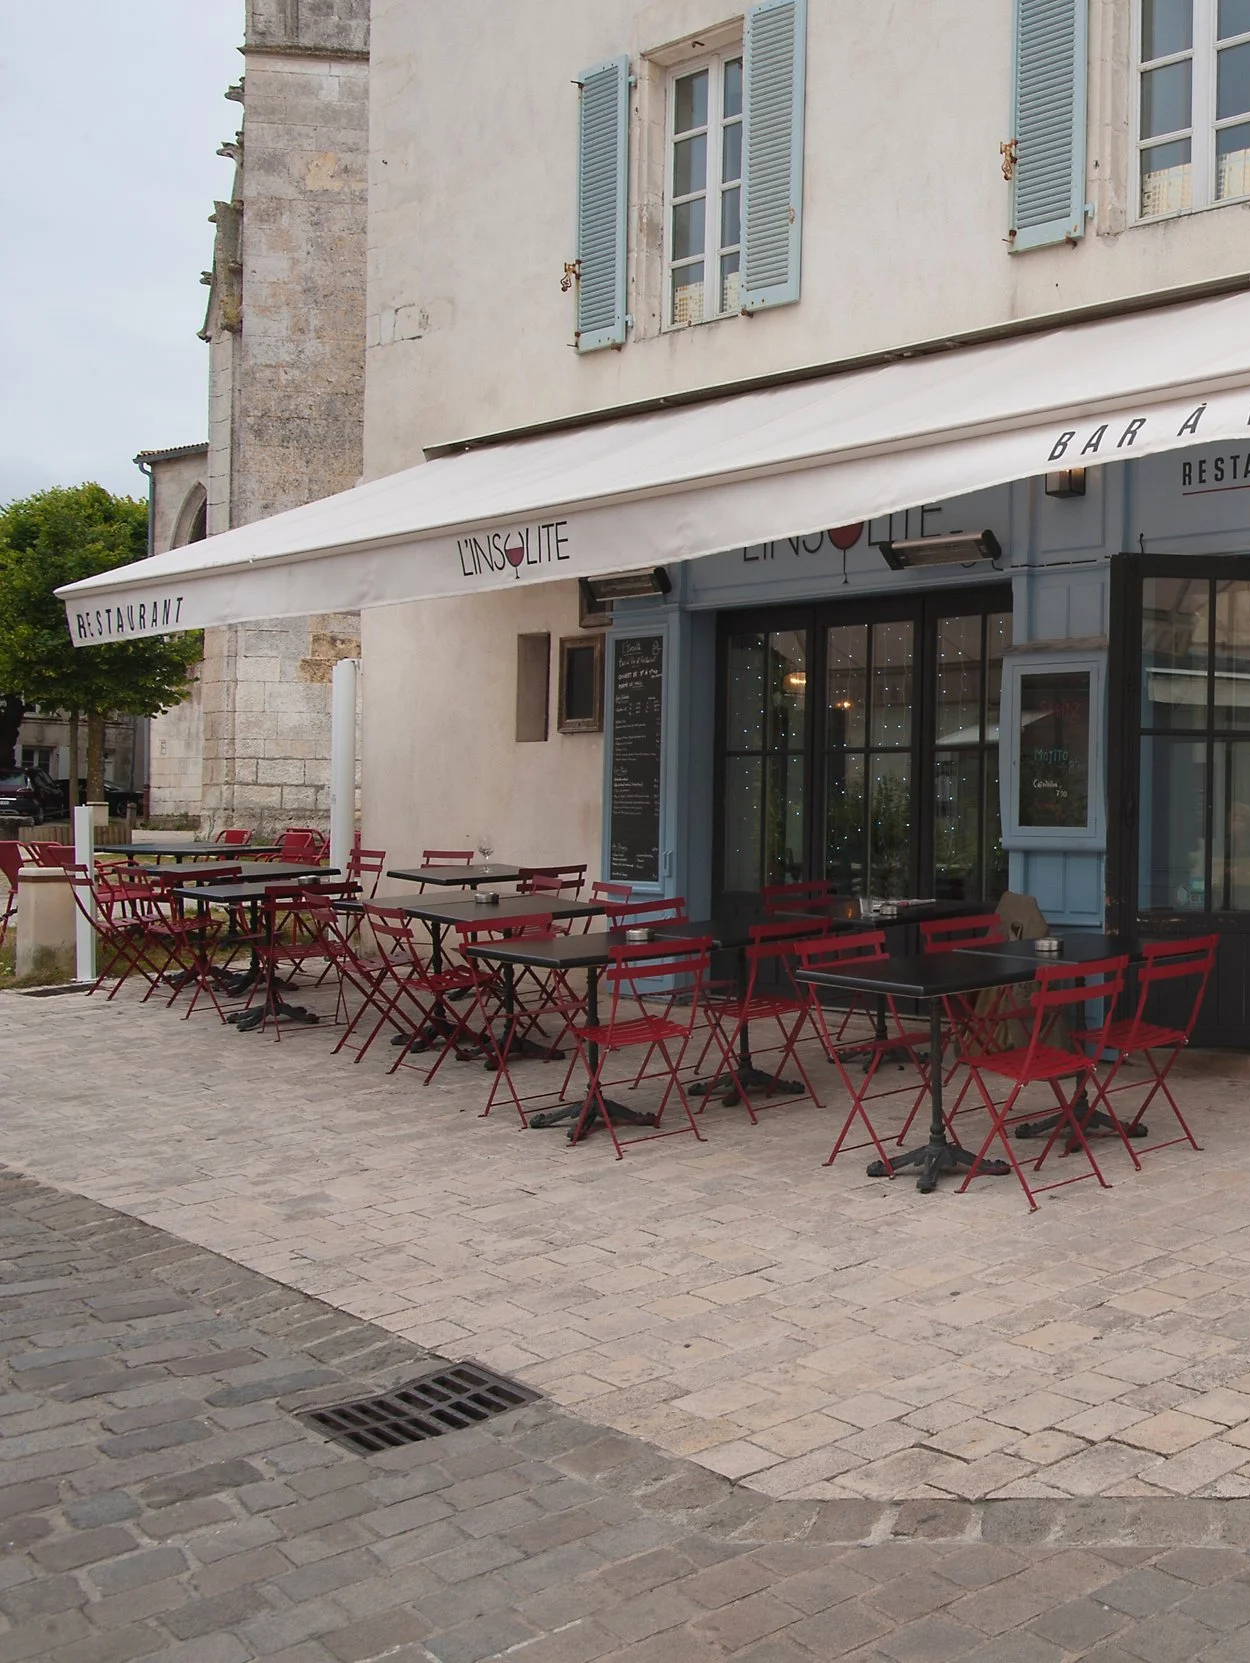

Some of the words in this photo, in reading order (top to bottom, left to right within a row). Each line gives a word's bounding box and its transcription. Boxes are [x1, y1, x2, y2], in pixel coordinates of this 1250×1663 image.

[76, 597, 183, 639] RESTAURANT
[1048, 418, 1147, 462] BAR
[1177, 402, 1208, 437] À
